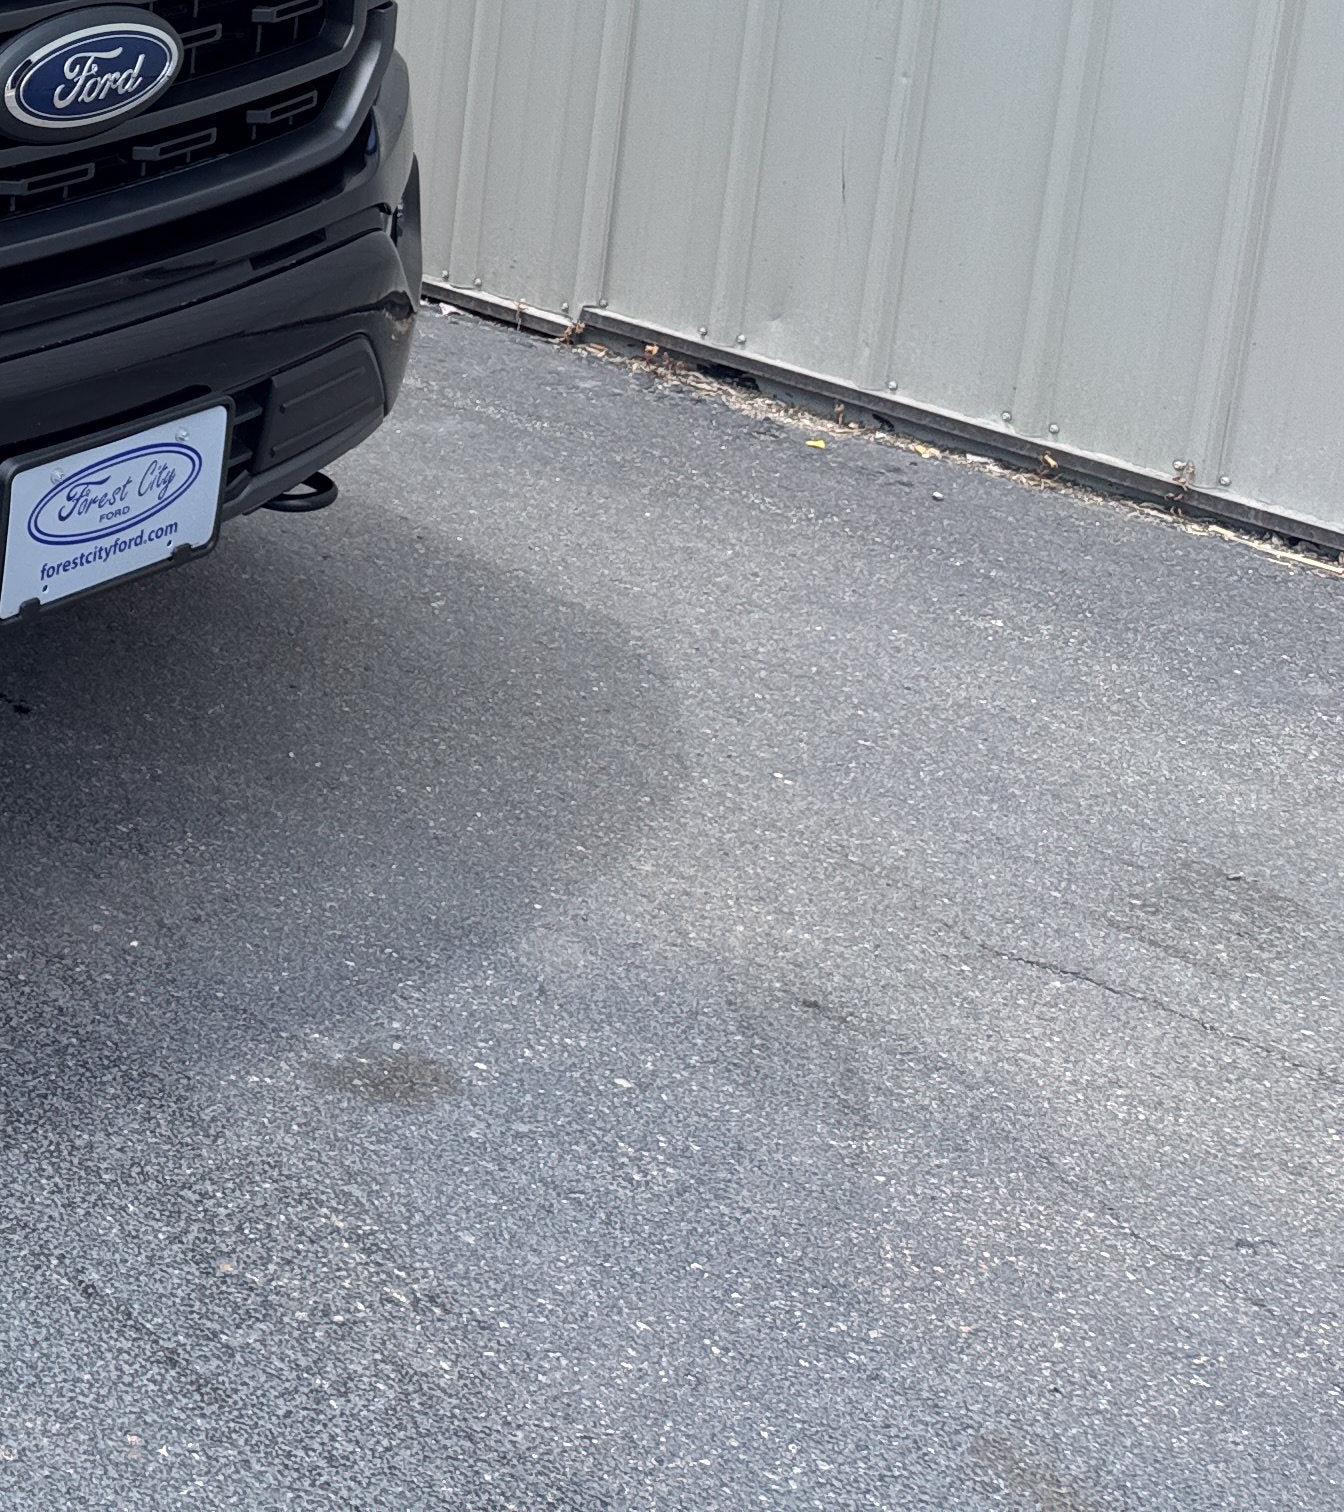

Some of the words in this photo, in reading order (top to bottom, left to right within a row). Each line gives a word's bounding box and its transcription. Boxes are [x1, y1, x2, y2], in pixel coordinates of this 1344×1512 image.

[53, 46, 146, 109] Ford
[57, 475, 133, 522] Forest
[137, 459, 176, 500] City
[99, 505, 131, 522] FORD
[40, 521, 178, 580] forestcityford.com
